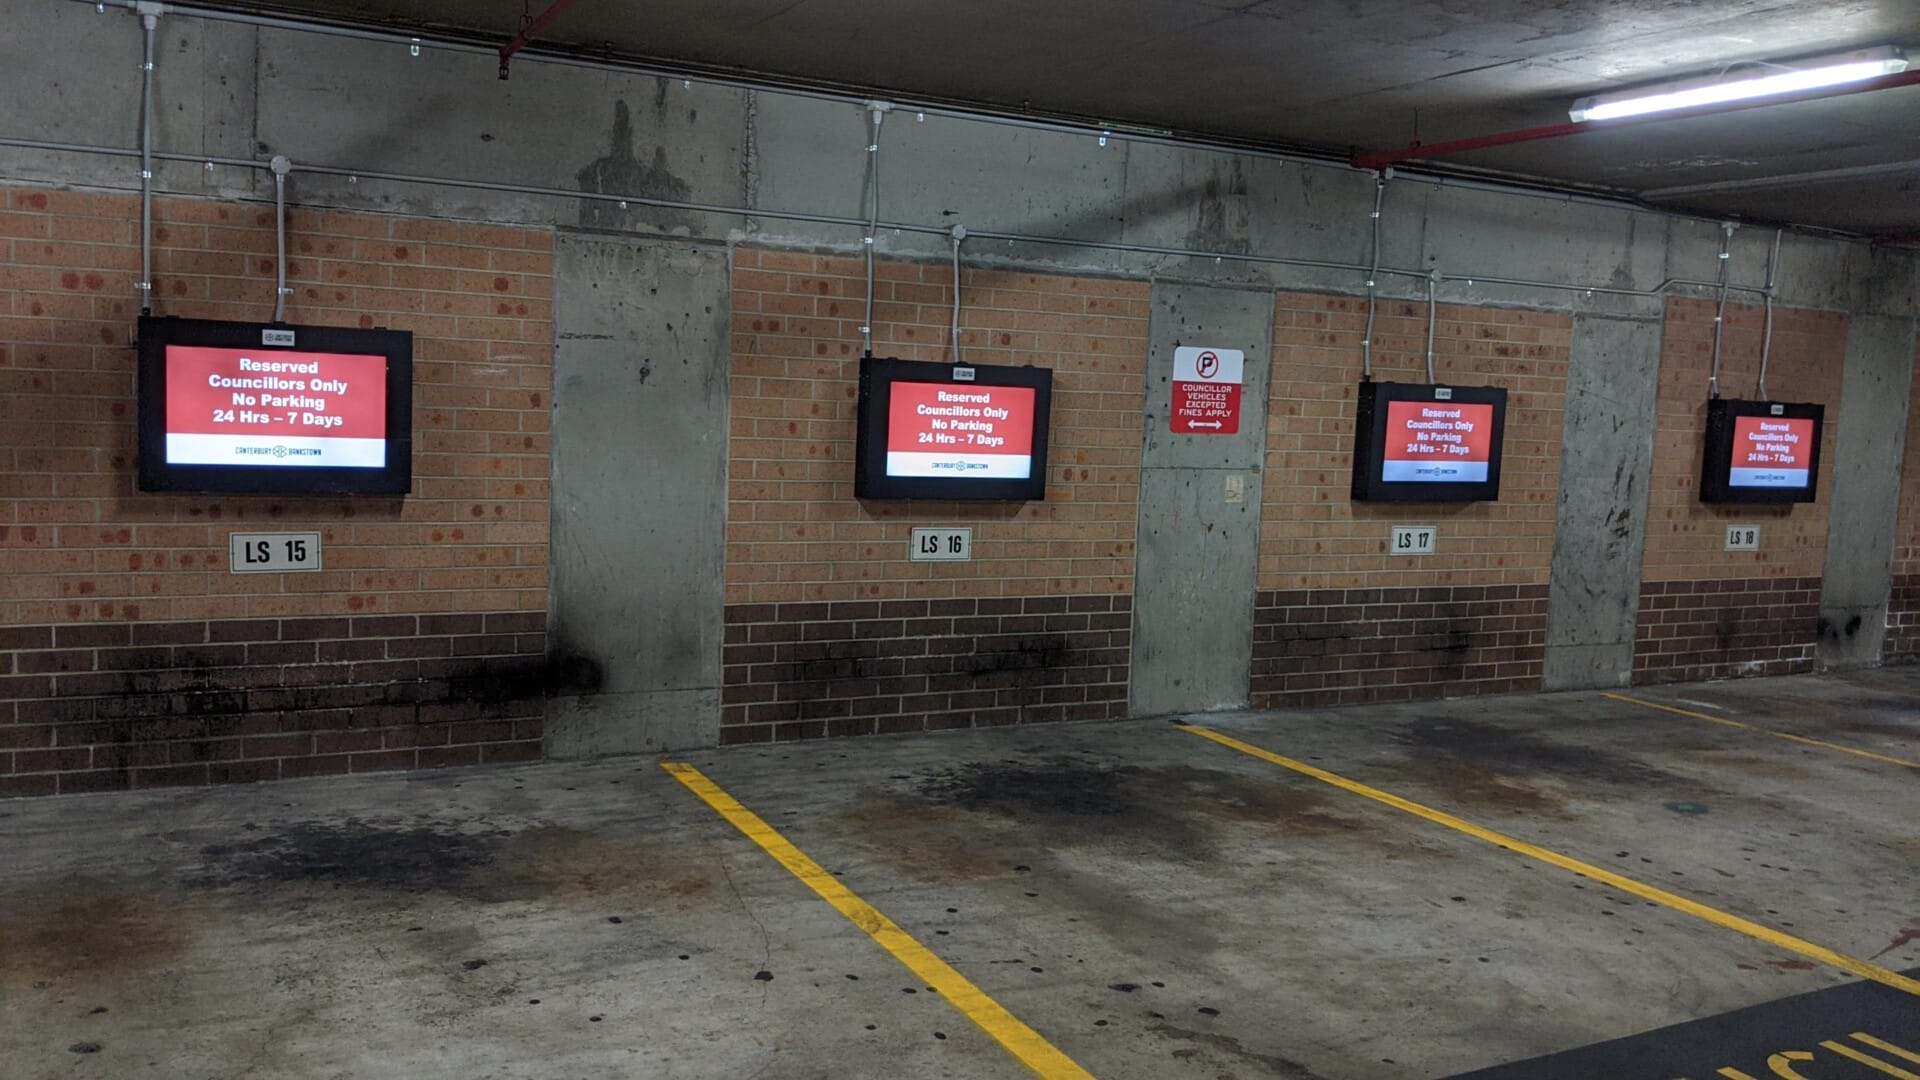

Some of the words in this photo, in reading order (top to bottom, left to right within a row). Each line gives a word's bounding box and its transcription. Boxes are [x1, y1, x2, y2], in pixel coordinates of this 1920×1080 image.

[239, 358, 318, 374] Reserved
[209, 375, 305, 390] Councillors
[310, 378, 347, 395] Only
[1182, 384, 1232, 392] COUNCILLOR
[232, 394, 256, 406] No
[261, 395, 325, 411] Parking
[938, 392, 990, 403] Reserved
[1188, 393, 1226, 401] VEHICLES
[1186, 401, 1226, 409] EXCEPTED
[213, 410, 234, 423] 24
[240, 411, 269, 423] Hrs
[288, 412, 297, 424] 7
[303, 414, 343, 427] Days
[917, 405, 980, 417] Councillors
[984, 408, 1008, 420] Only
[1422, 409, 1460, 418] Reserved
[932, 420, 947, 429] No
[950, 420, 993, 432] Parking
[1407, 420, 1453, 430] Councillors
[1455, 422, 1474, 432] Only
[1760, 422, 1789, 431] Reserved
[919, 434, 933, 444] 24
[936, 435, 955, 444] Hrs
[967, 435, 974, 444] 7
[977, 436, 1004, 447] Days
[1417, 432, 1429, 441] No
[1431, 433, 1462, 443] Parking
[1785, 434, 1799, 443] Only
[1407, 444, 1417, 452] 24
[1419, 444, 1435, 453] Hrs
[1442, 445, 1447, 453] 7
[1449, 445, 1469, 455] Days
[1756, 443, 1765, 451] No
[1766, 444, 1790, 453] Parking
[1758, 454, 1769, 462] Hrs
[1398, 533, 1411, 548] LS
[1418, 533, 1429, 547] 17
[1730, 531, 1740, 544] LS
[1746, 531, 1753, 544] 18
[922, 536, 938, 553] LS
[948, 536, 962, 552] 16
[246, 541, 270, 563] LS
[285, 540, 306, 562] 15
